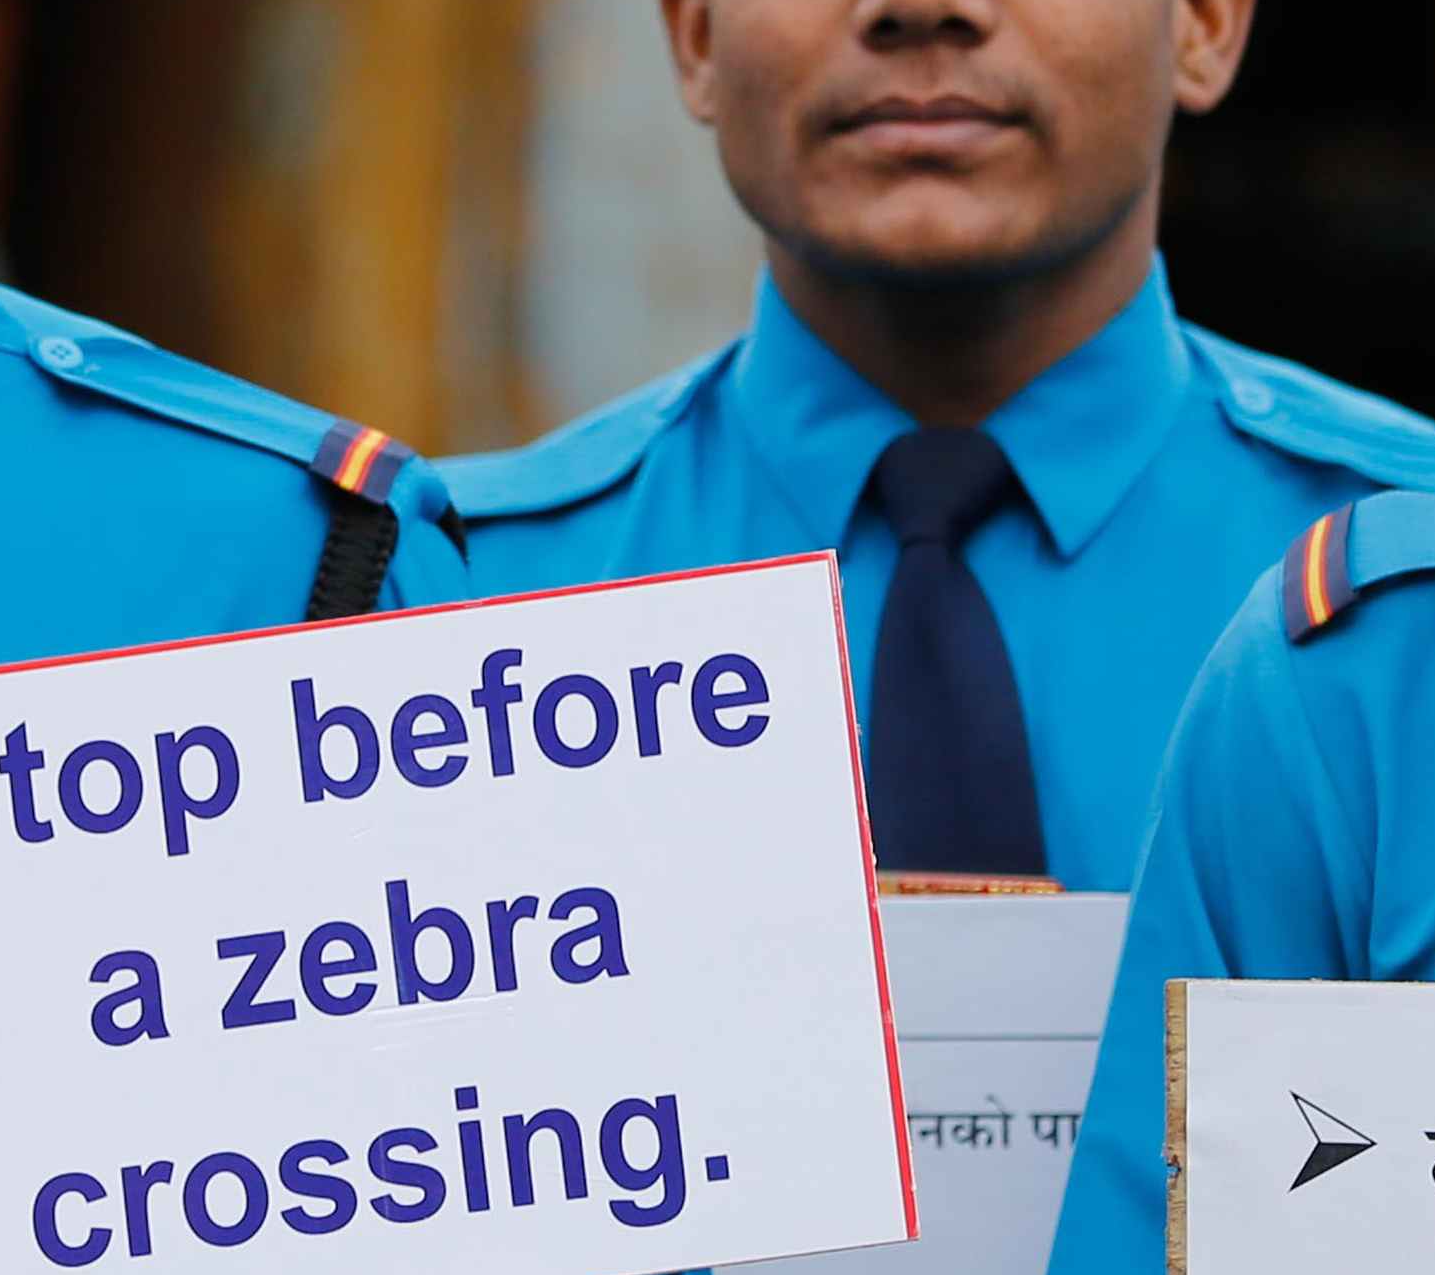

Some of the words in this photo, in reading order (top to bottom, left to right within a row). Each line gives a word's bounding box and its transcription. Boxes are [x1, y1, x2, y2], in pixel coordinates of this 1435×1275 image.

[291, 649, 769, 802] before
[90, 951, 170, 1046] a
[217, 880, 629, 1029] zebra
[33, 1086, 729, 1267] crossing.
[907, 1093, 1013, 1150] नको
[1029, 1112, 1082, 1150] पा
